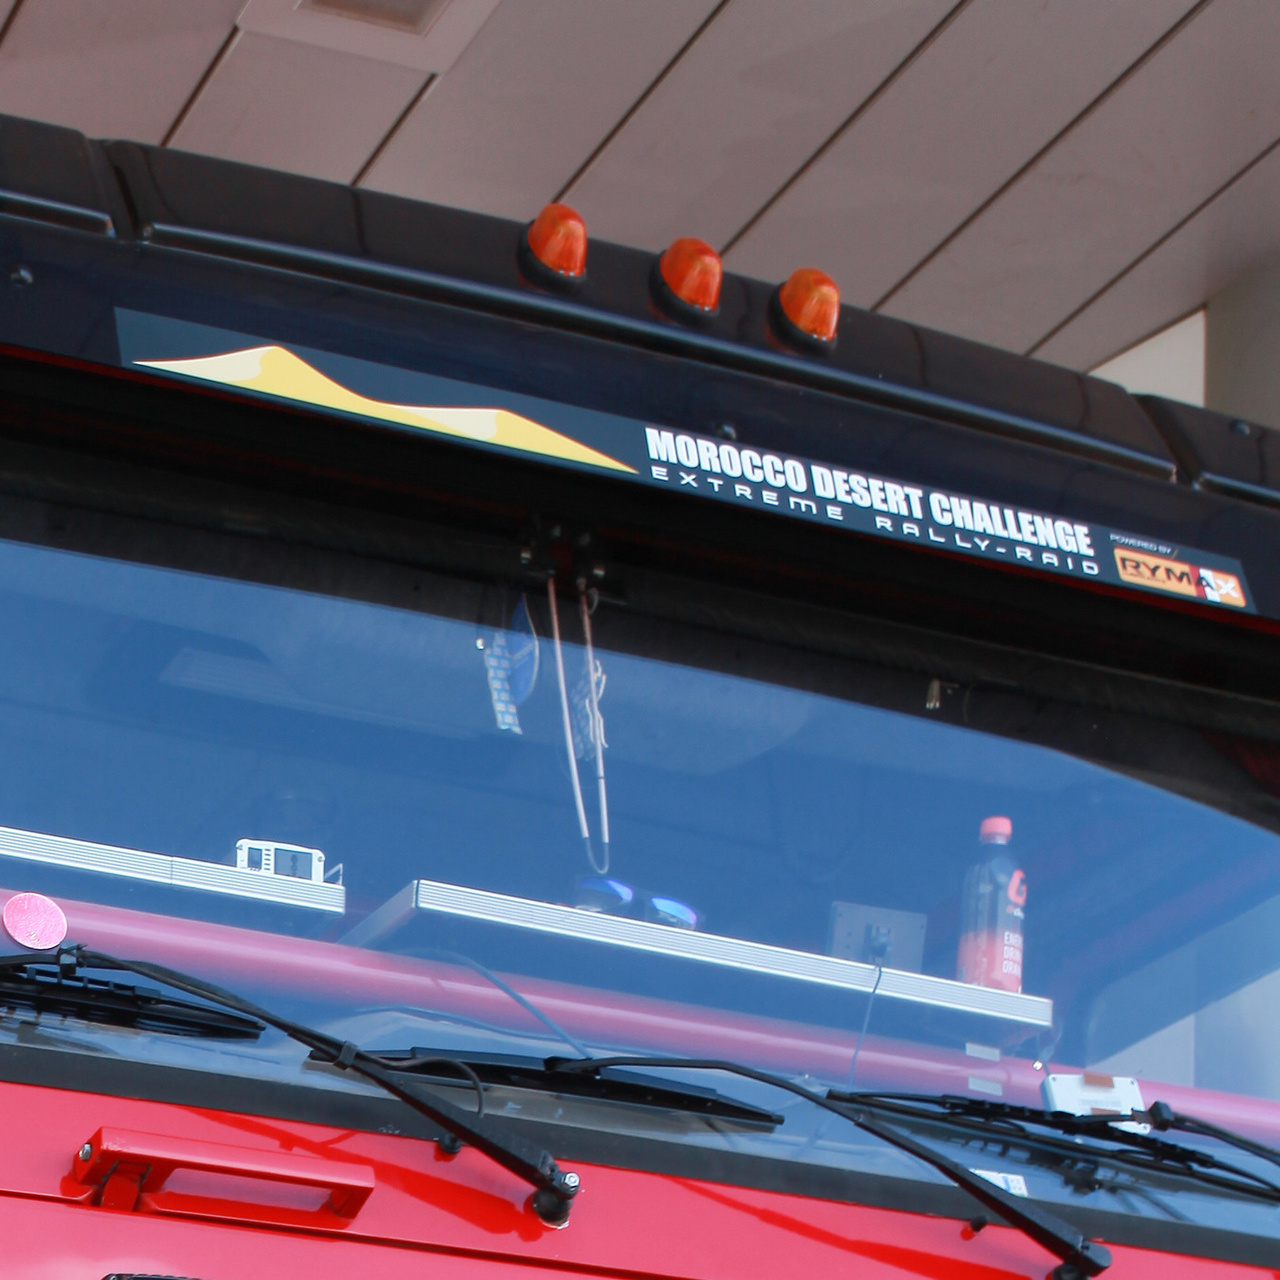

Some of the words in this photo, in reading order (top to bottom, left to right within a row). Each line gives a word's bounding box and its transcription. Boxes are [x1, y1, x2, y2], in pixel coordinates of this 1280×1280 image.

[645, 427, 807, 493] MOROCCO
[810, 464, 924, 520] DESERT
[929, 492, 1096, 557] CHALLENGE
[651, 465, 844, 521] EXTREME
[874, 515, 1100, 576] RALLY-RAID
[1120, 556, 1241, 599] RYMAX
